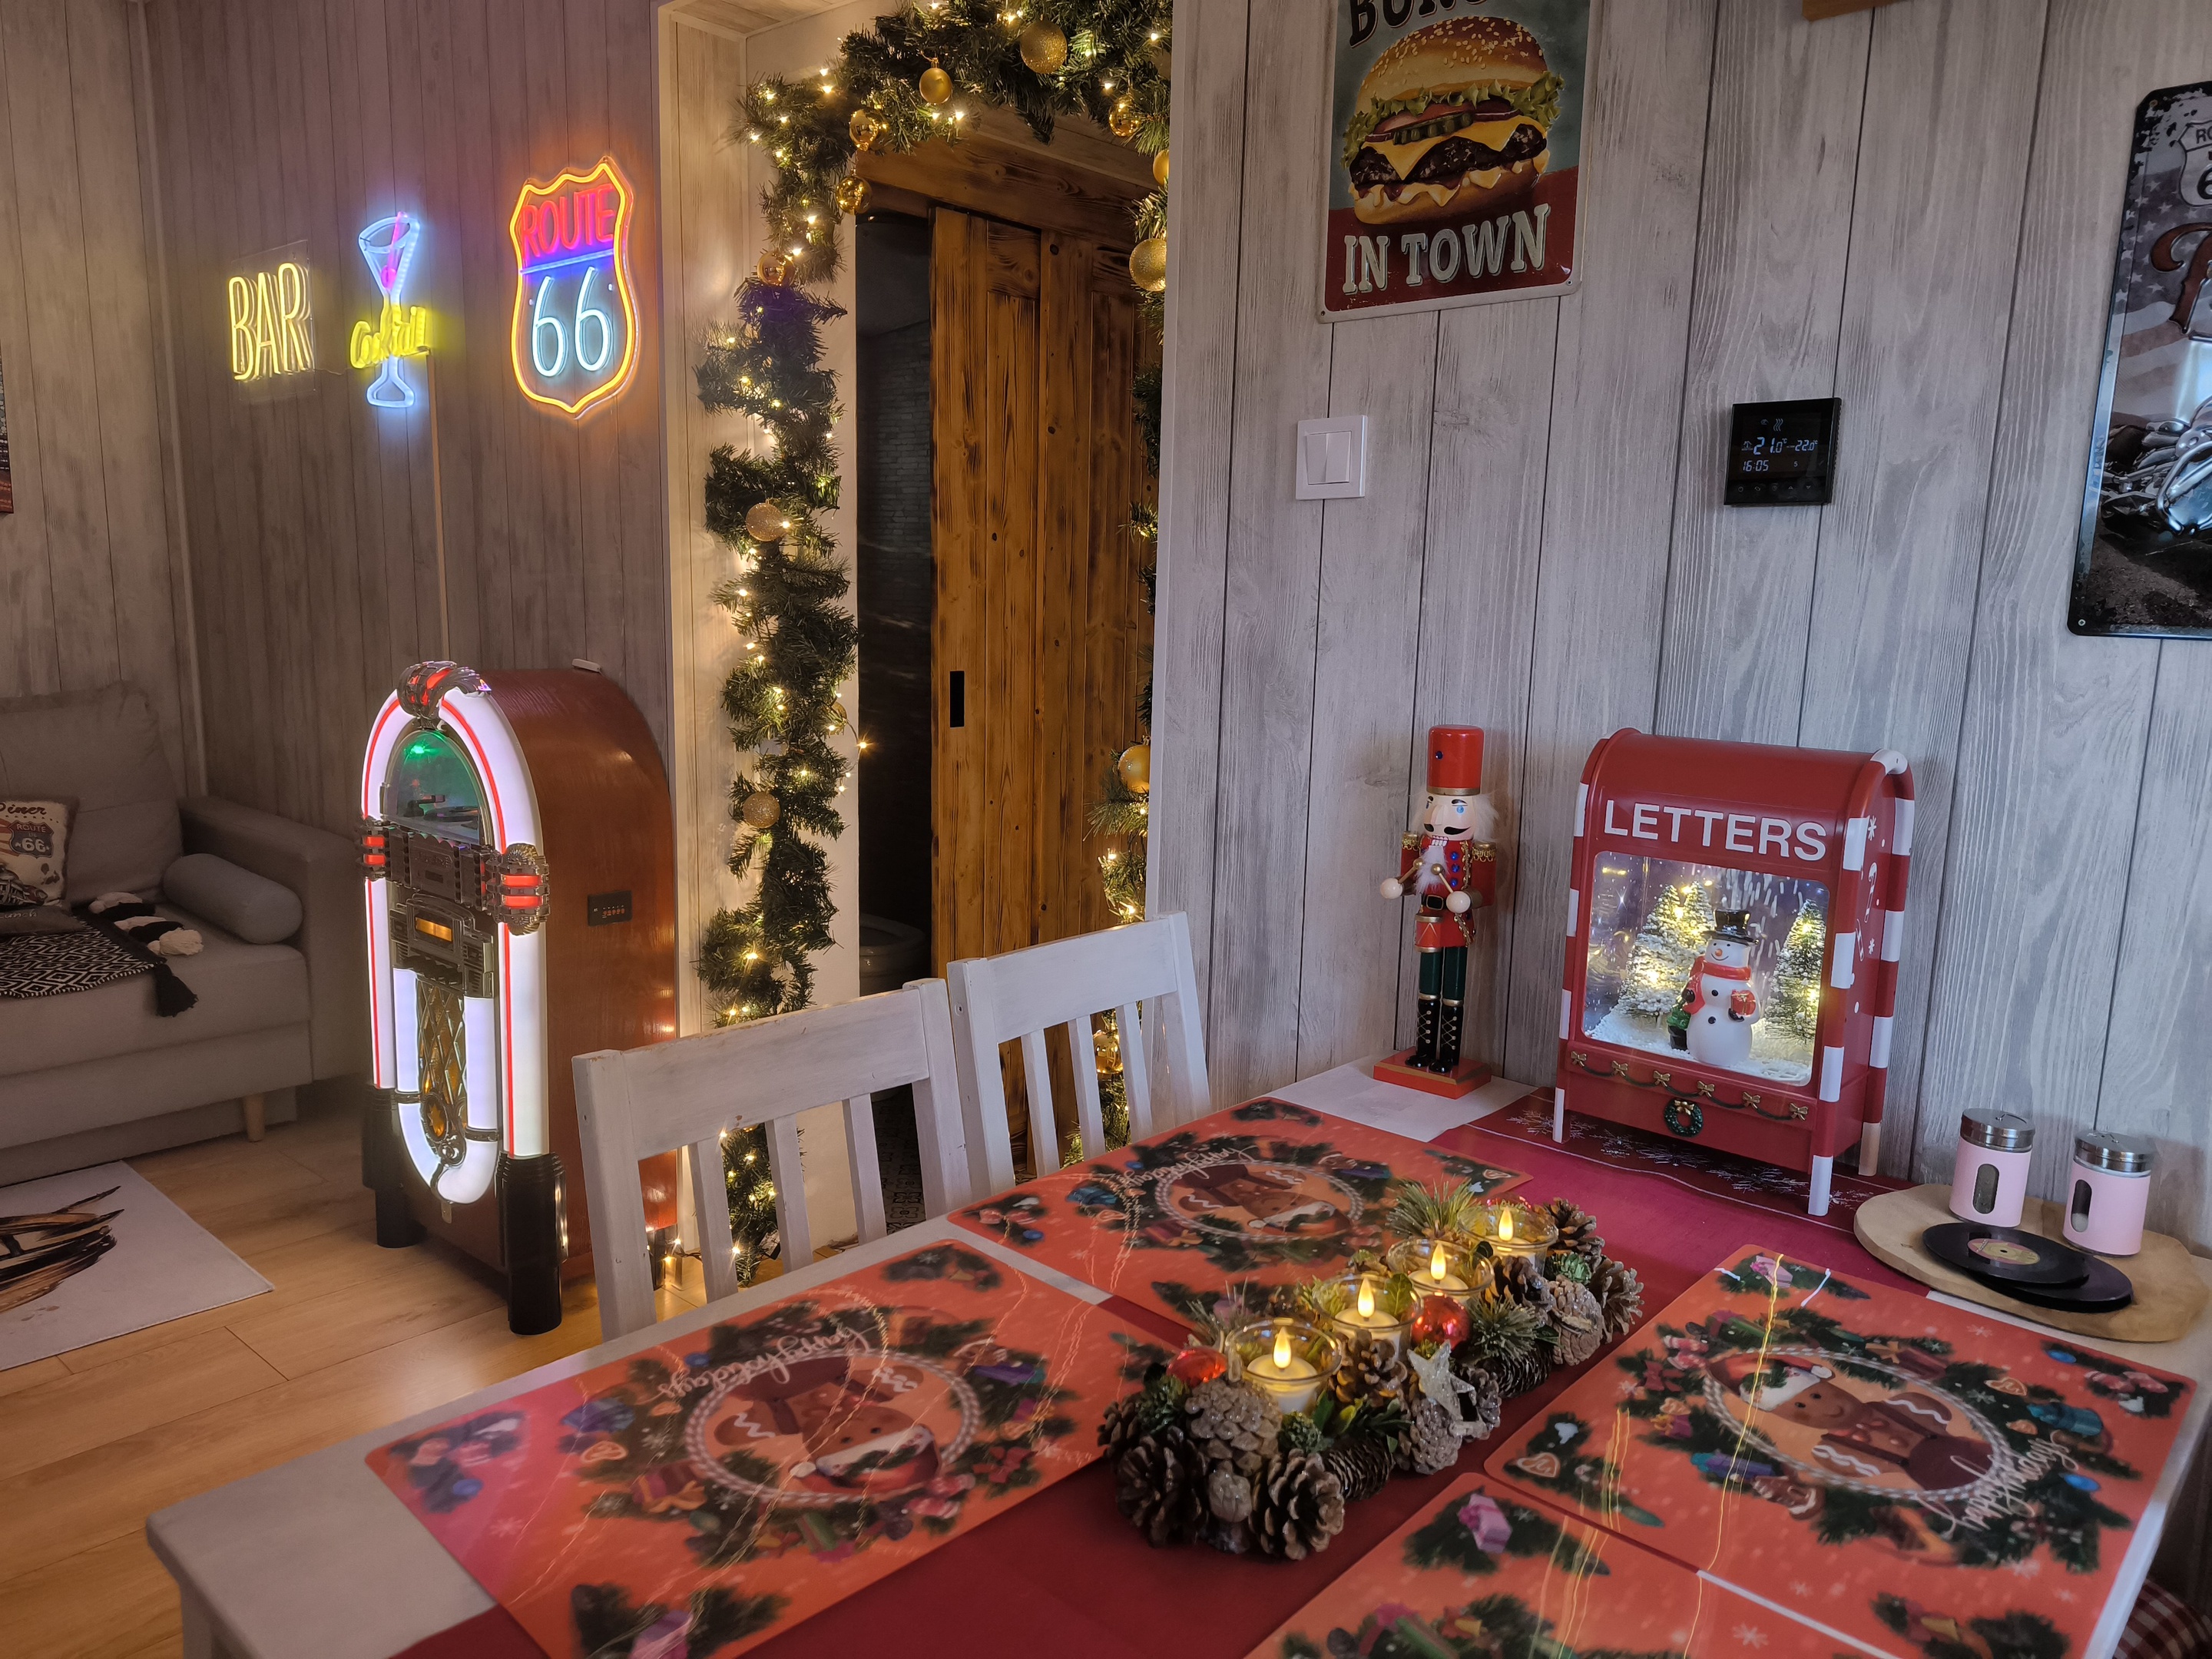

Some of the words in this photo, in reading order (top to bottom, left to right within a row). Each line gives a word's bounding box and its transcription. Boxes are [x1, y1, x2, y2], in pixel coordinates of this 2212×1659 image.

[521, 183, 614, 257] ROUTE
[1342, 234, 1390, 295] IN
[1400, 203, 1551, 287] TOWN
[228, 262, 312, 382] BAR
[531, 267, 614, 377] 66
[1743, 459, 1770, 472] 16:05
[16, 823, 47, 833] ROUTE
[22, 837, 46, 853] 66
[1604, 800, 1827, 861] LETTERS
